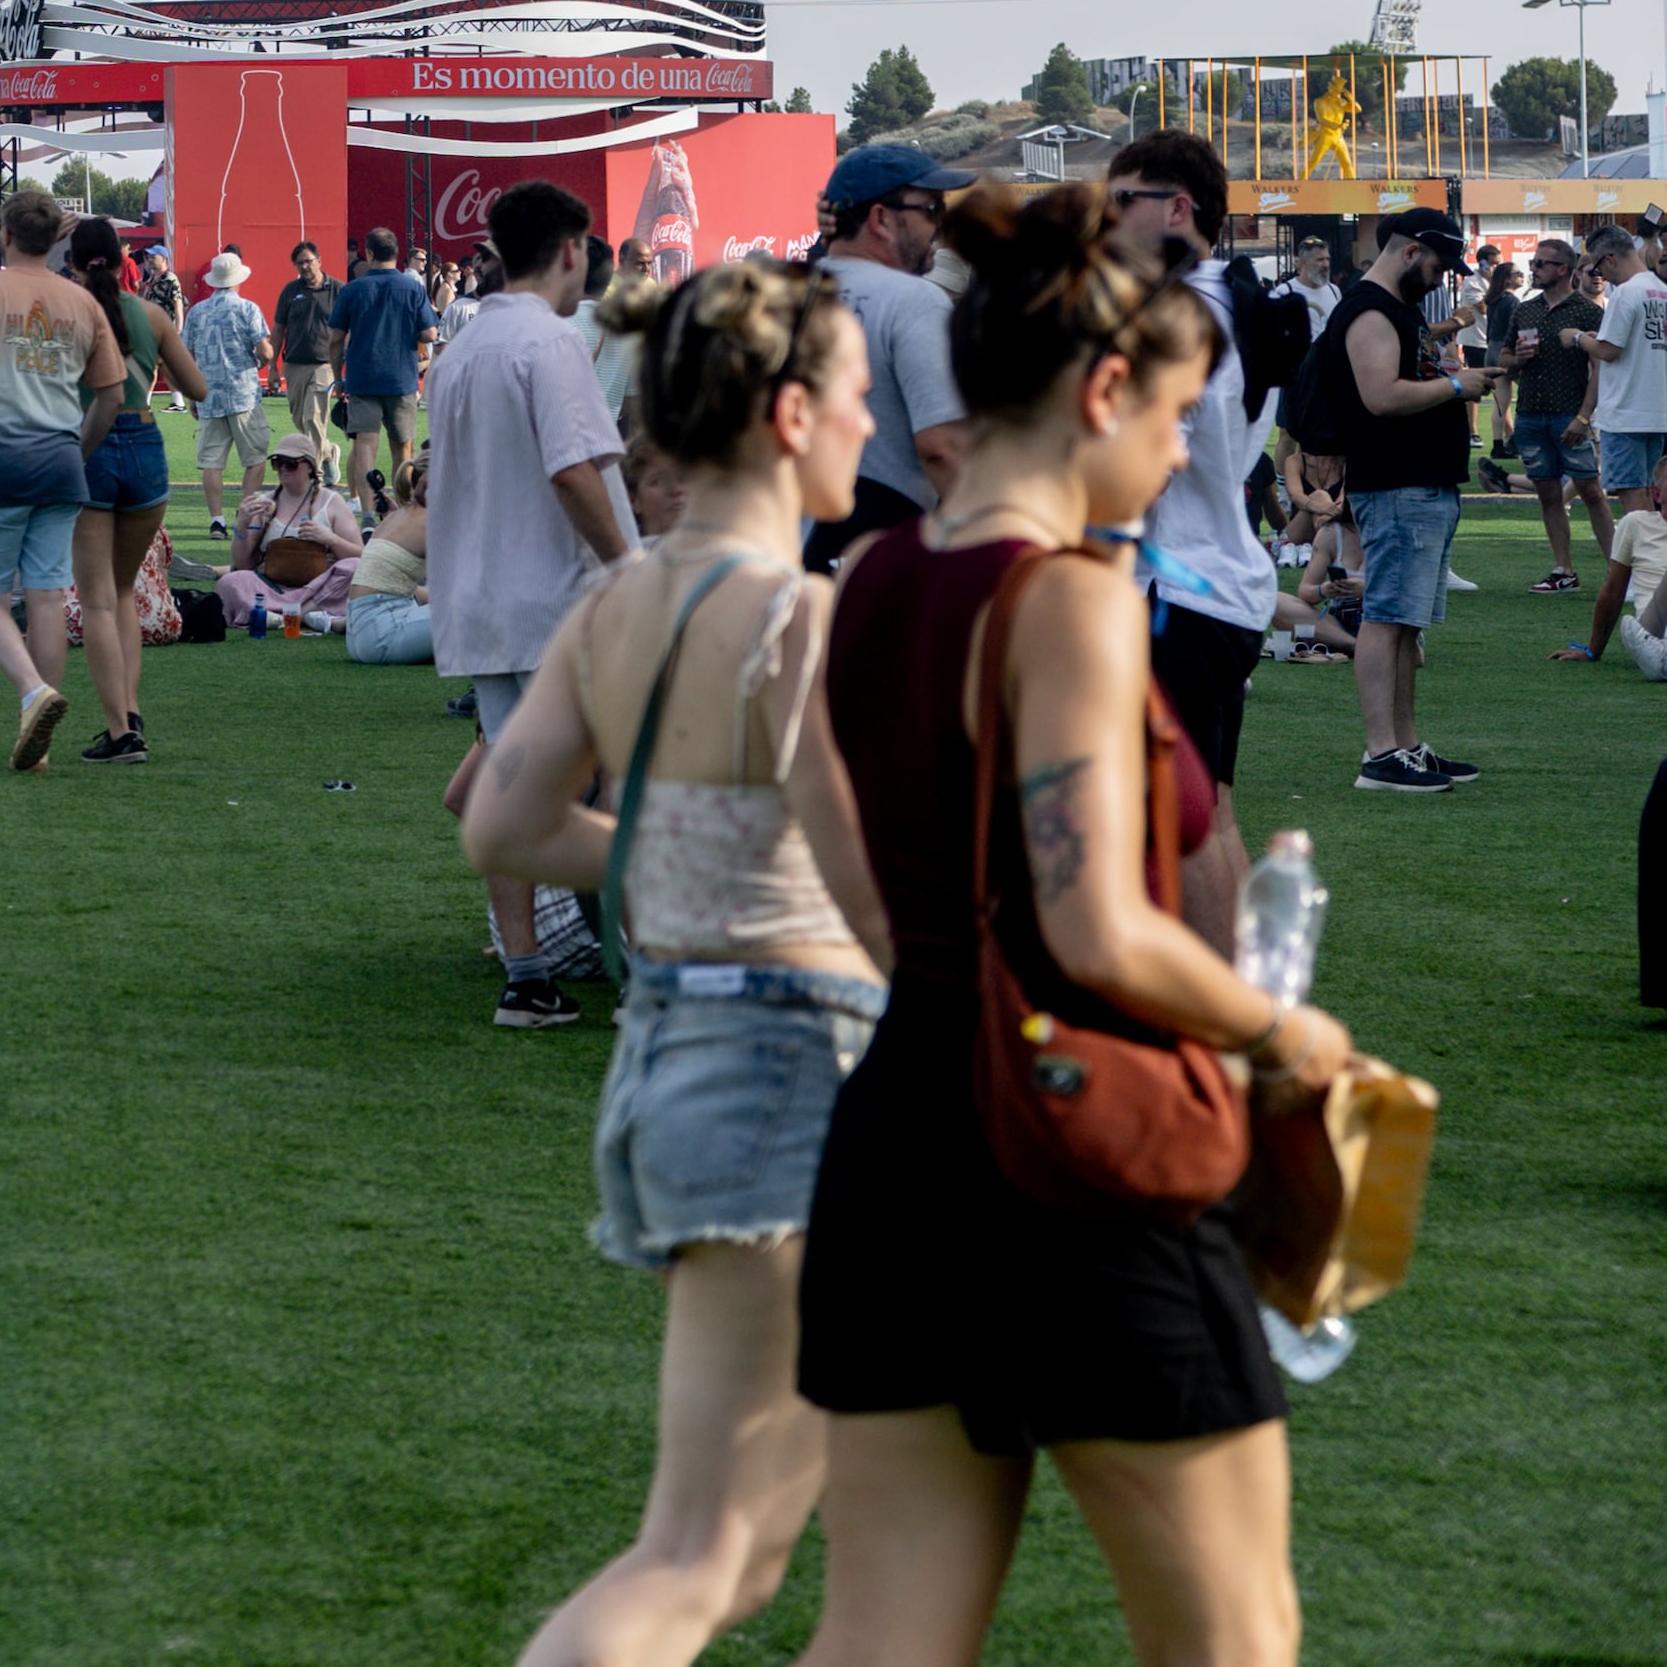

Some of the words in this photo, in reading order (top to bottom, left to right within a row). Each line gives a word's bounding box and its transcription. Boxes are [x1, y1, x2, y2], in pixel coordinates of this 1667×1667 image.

[412, 63, 452, 90] Es
[460, 63, 615, 90] momento
[621, 62, 655, 90] de
[660, 67, 702, 92] una
[1251, 184, 1300, 193] WALKERS
[1370, 184, 1419, 193] WALKERS
